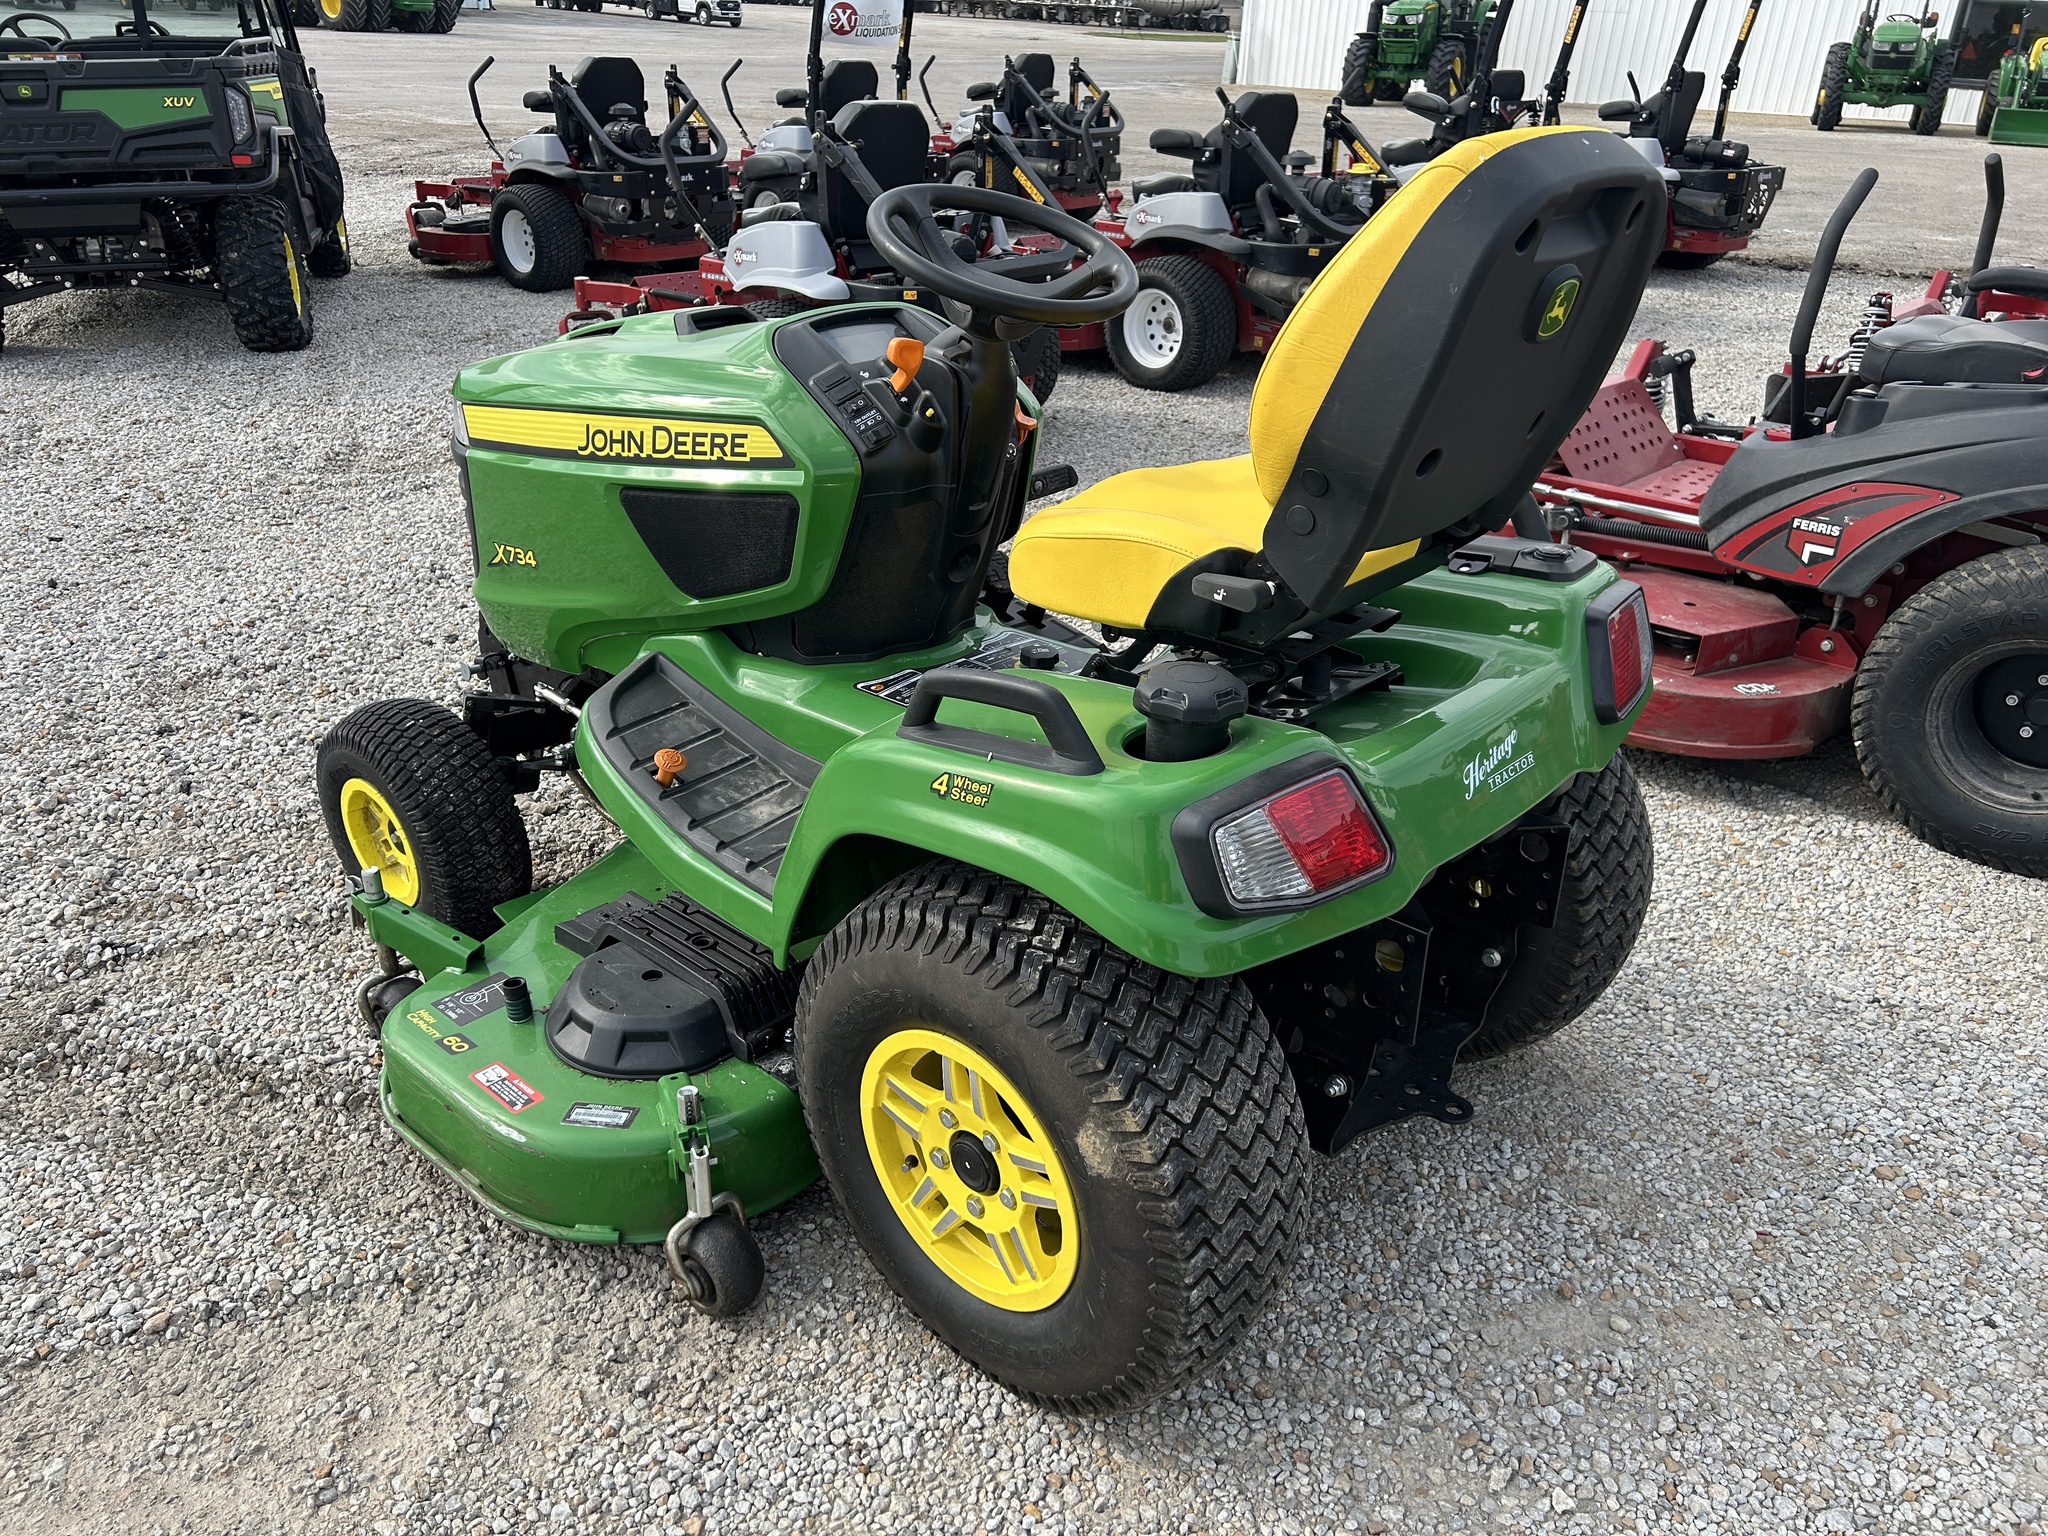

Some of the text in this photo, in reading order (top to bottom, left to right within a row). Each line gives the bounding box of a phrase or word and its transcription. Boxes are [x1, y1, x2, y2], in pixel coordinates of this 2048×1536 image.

[163, 96, 195, 108] XUV
[577, 423, 750, 460] JOHN DEERE
[1792, 518, 1842, 537] FERRIS
[490, 541, 538, 568] X734
[1904, 611, 2041, 687] CARLSTAR
[1462, 729, 1518, 800] Heritage
[1487, 753, 1535, 790] TRACTOR
[931, 772, 992, 797] 4 Wheel
[950, 787, 989, 807] Steer
[406, 1013, 443, 1039] CAPACITY
[442, 1036, 470, 1052] 60
